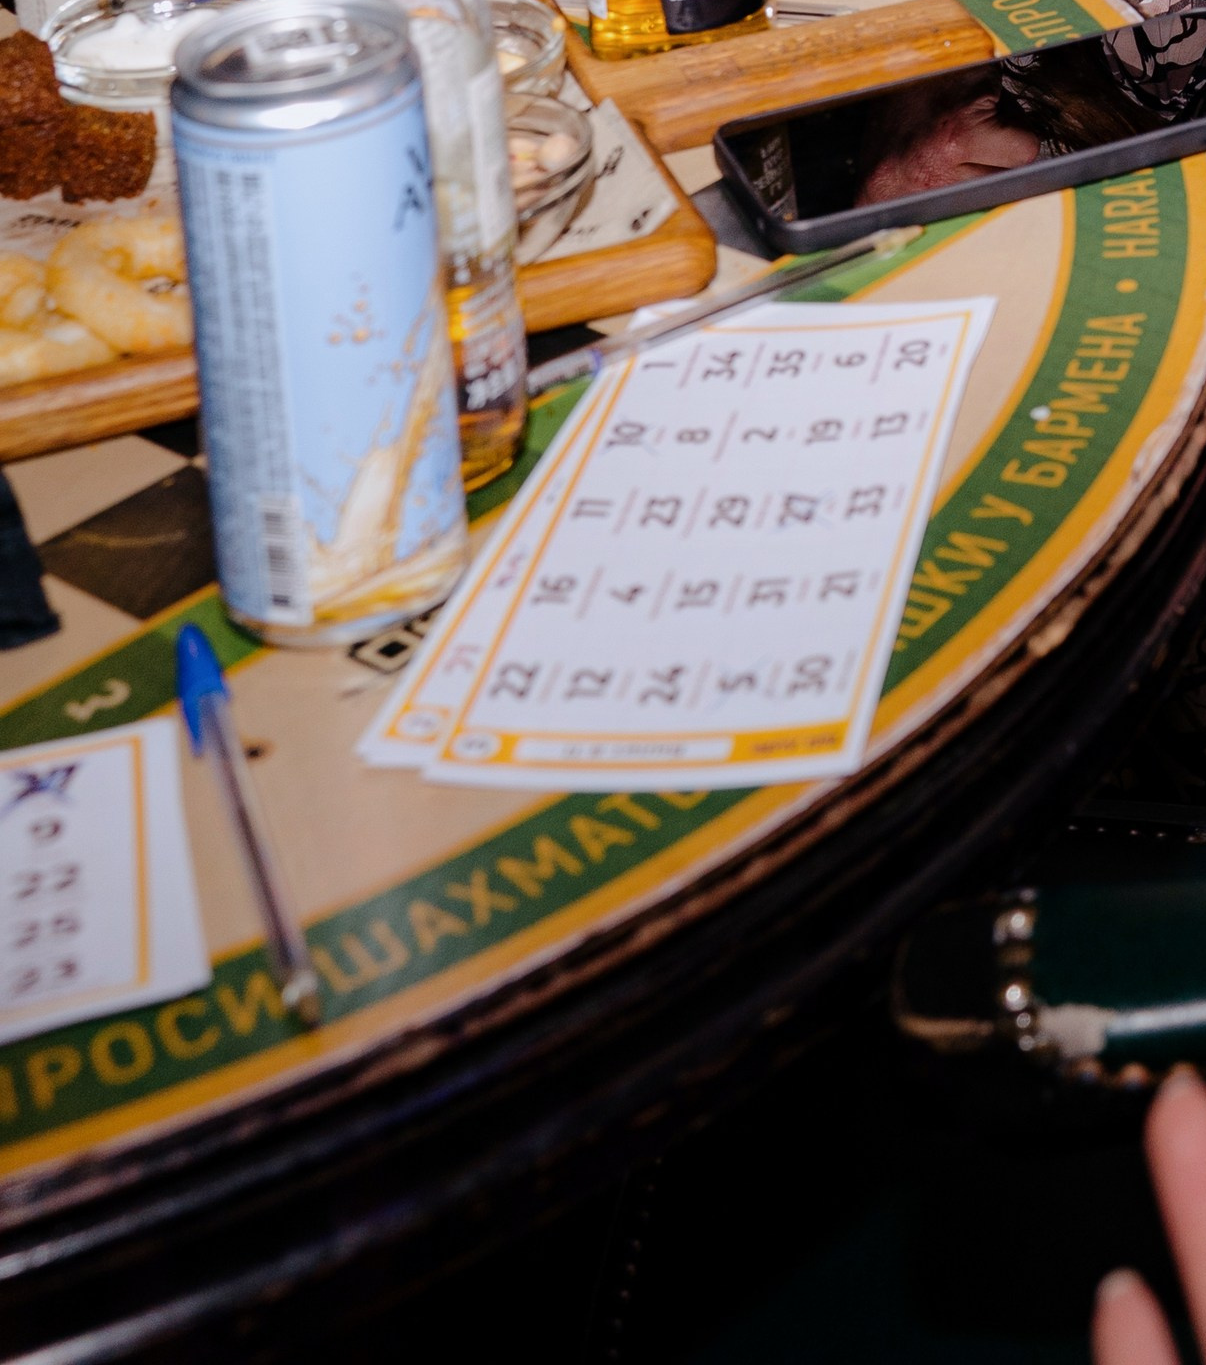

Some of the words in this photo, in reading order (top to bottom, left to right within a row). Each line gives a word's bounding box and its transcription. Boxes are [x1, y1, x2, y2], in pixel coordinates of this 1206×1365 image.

[1101, 167, 1161, 259] HARA
[491, 663, 540, 699] 22
[532, 574, 578, 606] 16
[572, 497, 613, 521] 11
[643, 361, 676, 370] 1
[565, 668, 611, 700] 12
[611, 583, 645, 604] 4
[640, 496, 682, 528] 23
[677, 427, 710, 444] 8
[703, 350, 742, 381] 34
[639, 664, 684, 706] 24
[675, 579, 719, 609] 15
[709, 495, 751, 528] 29
[743, 427, 777, 443] 2
[768, 348, 806, 379] 35
[716, 672, 758, 694] 5
[747, 576, 789, 607] 31
[806, 419, 845, 446] 19
[834, 352, 867, 369] 6
[787, 654, 832, 697] 30
[819, 571, 860, 602] 21
[845, 485, 887, 519] 33
[871, 411, 908, 439] 13
[895, 339, 930, 369] 20
[969, 493, 1034, 526] У
[1000, 312, 1149, 489] БАРМЕНА
[892, 531, 1009, 652] ШКИ
